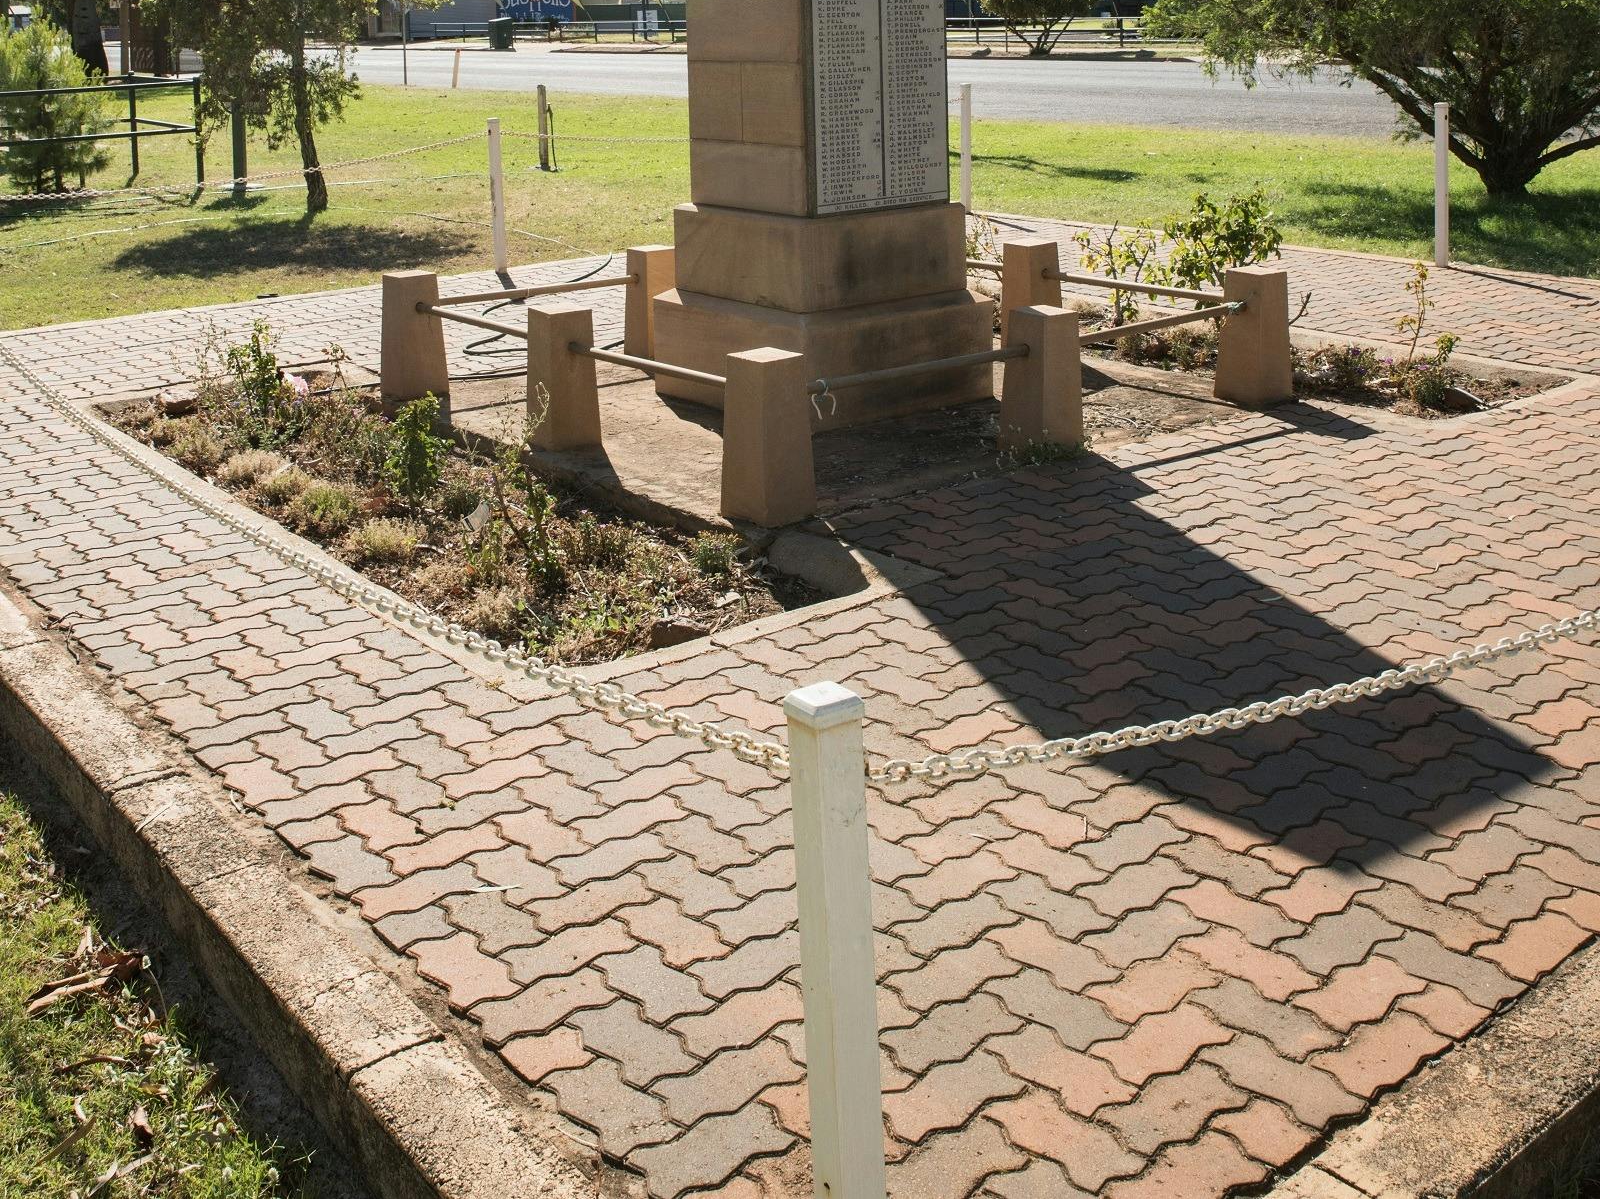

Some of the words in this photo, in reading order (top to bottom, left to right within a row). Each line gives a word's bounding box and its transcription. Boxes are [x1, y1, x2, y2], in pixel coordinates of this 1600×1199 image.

[828, 108, 873, 116] GREENWOOD
[830, 173, 879, 183] HUNGERFORD
[831, 193, 865, 202] JOHNSON
